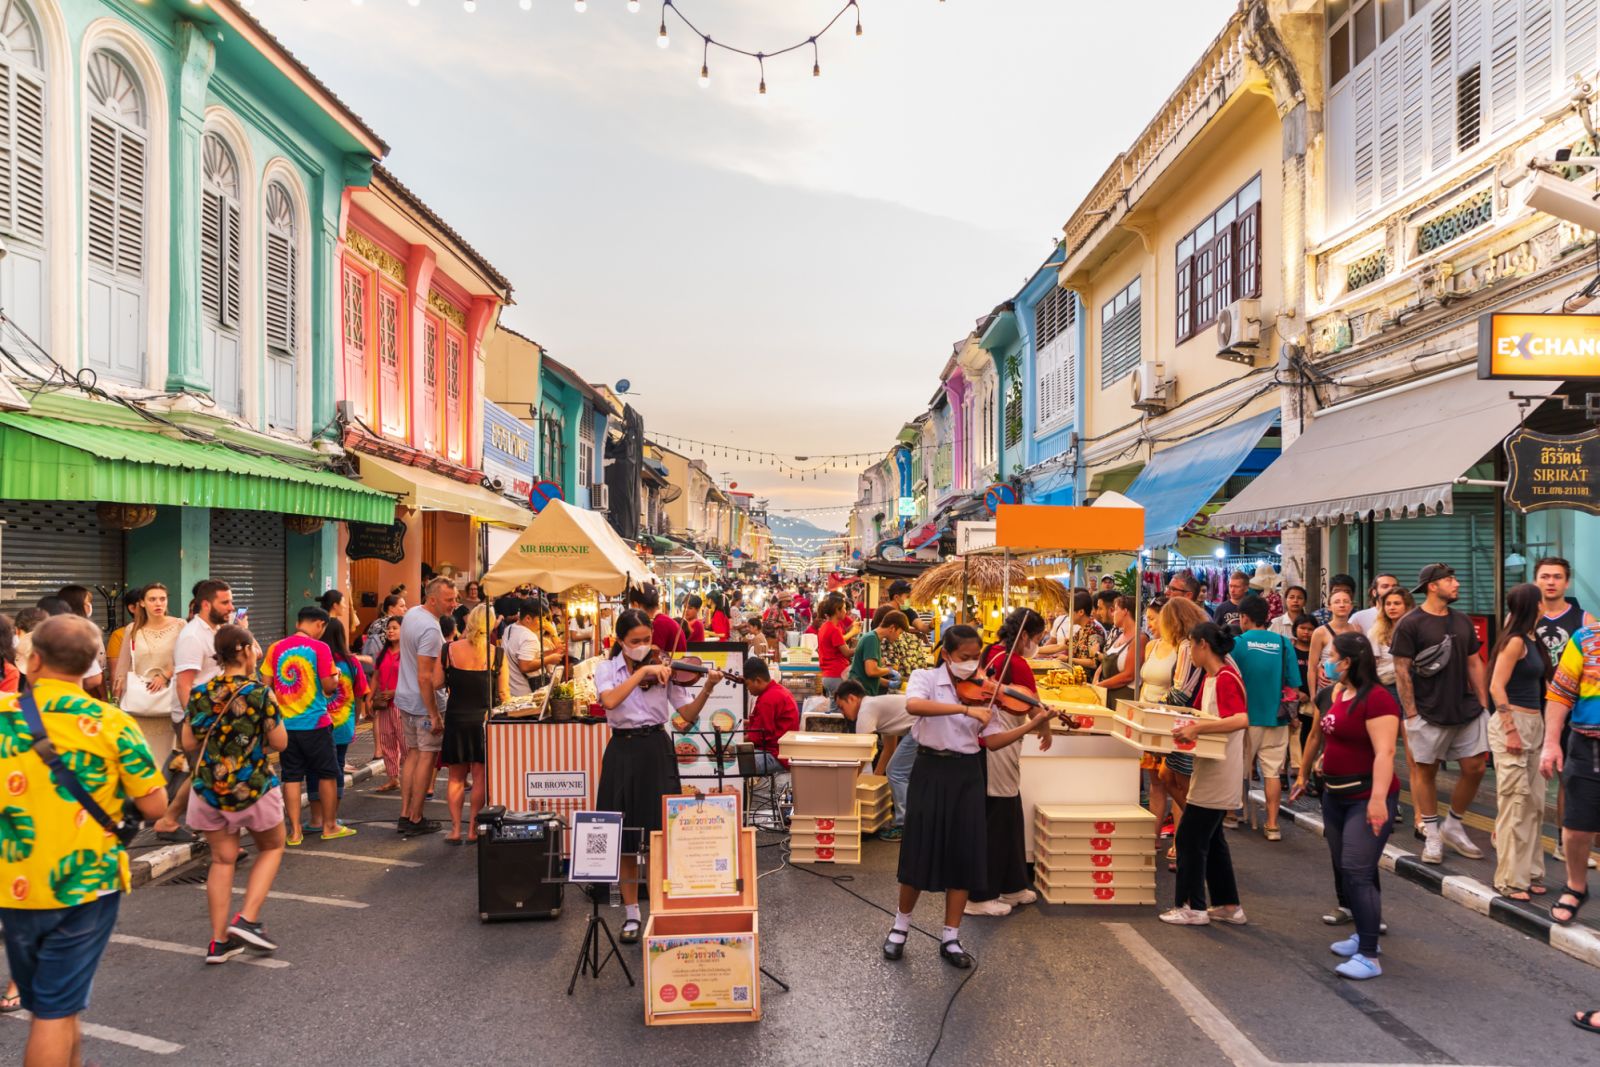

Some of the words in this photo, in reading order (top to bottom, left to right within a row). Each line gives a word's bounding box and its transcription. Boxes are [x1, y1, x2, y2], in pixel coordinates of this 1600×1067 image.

[1497, 333, 1600, 360] EXCHAN
[1533, 469, 1589, 482] SIRIRAT
[520, 545, 536, 553] MR
[538, 545, 589, 554] BROWNIE
[544, 781, 583, 789] BROWNIE
